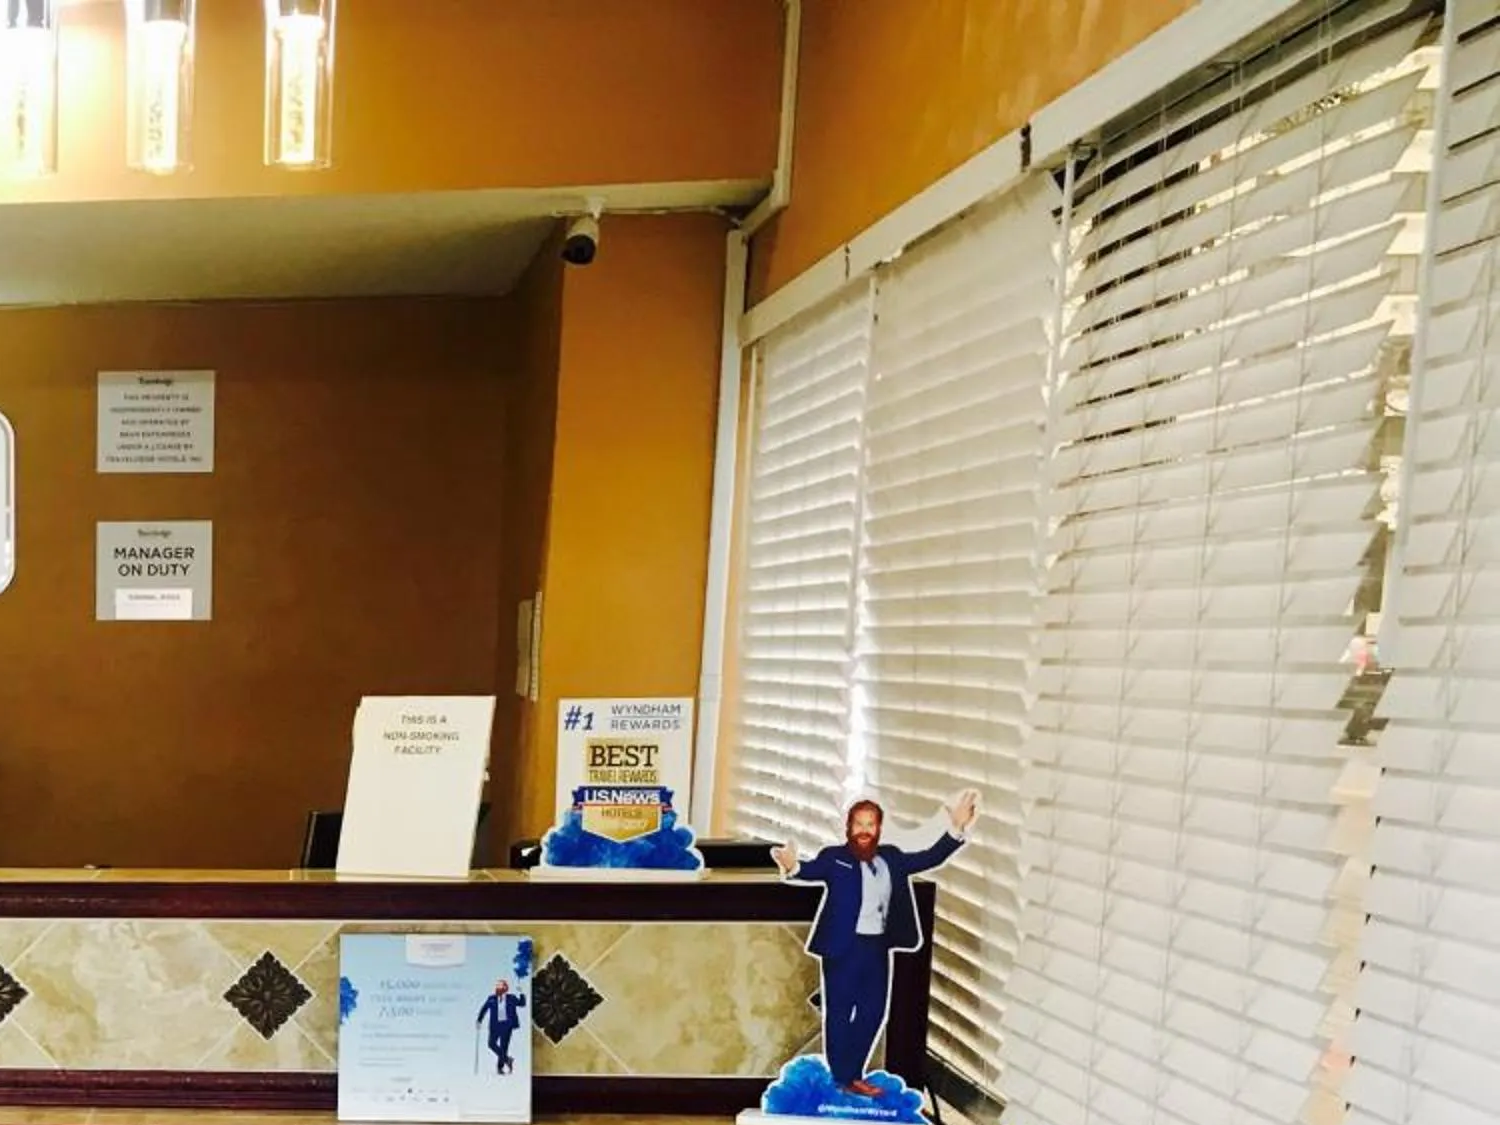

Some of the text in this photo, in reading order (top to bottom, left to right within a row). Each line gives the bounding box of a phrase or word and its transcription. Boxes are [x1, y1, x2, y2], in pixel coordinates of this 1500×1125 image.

[114, 546, 195, 559] MANAGER
[117, 563, 190, 576] ON DUTY
[401, 715, 448, 725] THIS IS A
[564, 703, 682, 731] #1 WYNDHAM
[611, 719, 682, 731] REWARDS
[382, 730, 460, 742] NON-SMOKING
[393, 745, 443, 755] FACILITY
[588, 744, 659, 767] BEST
